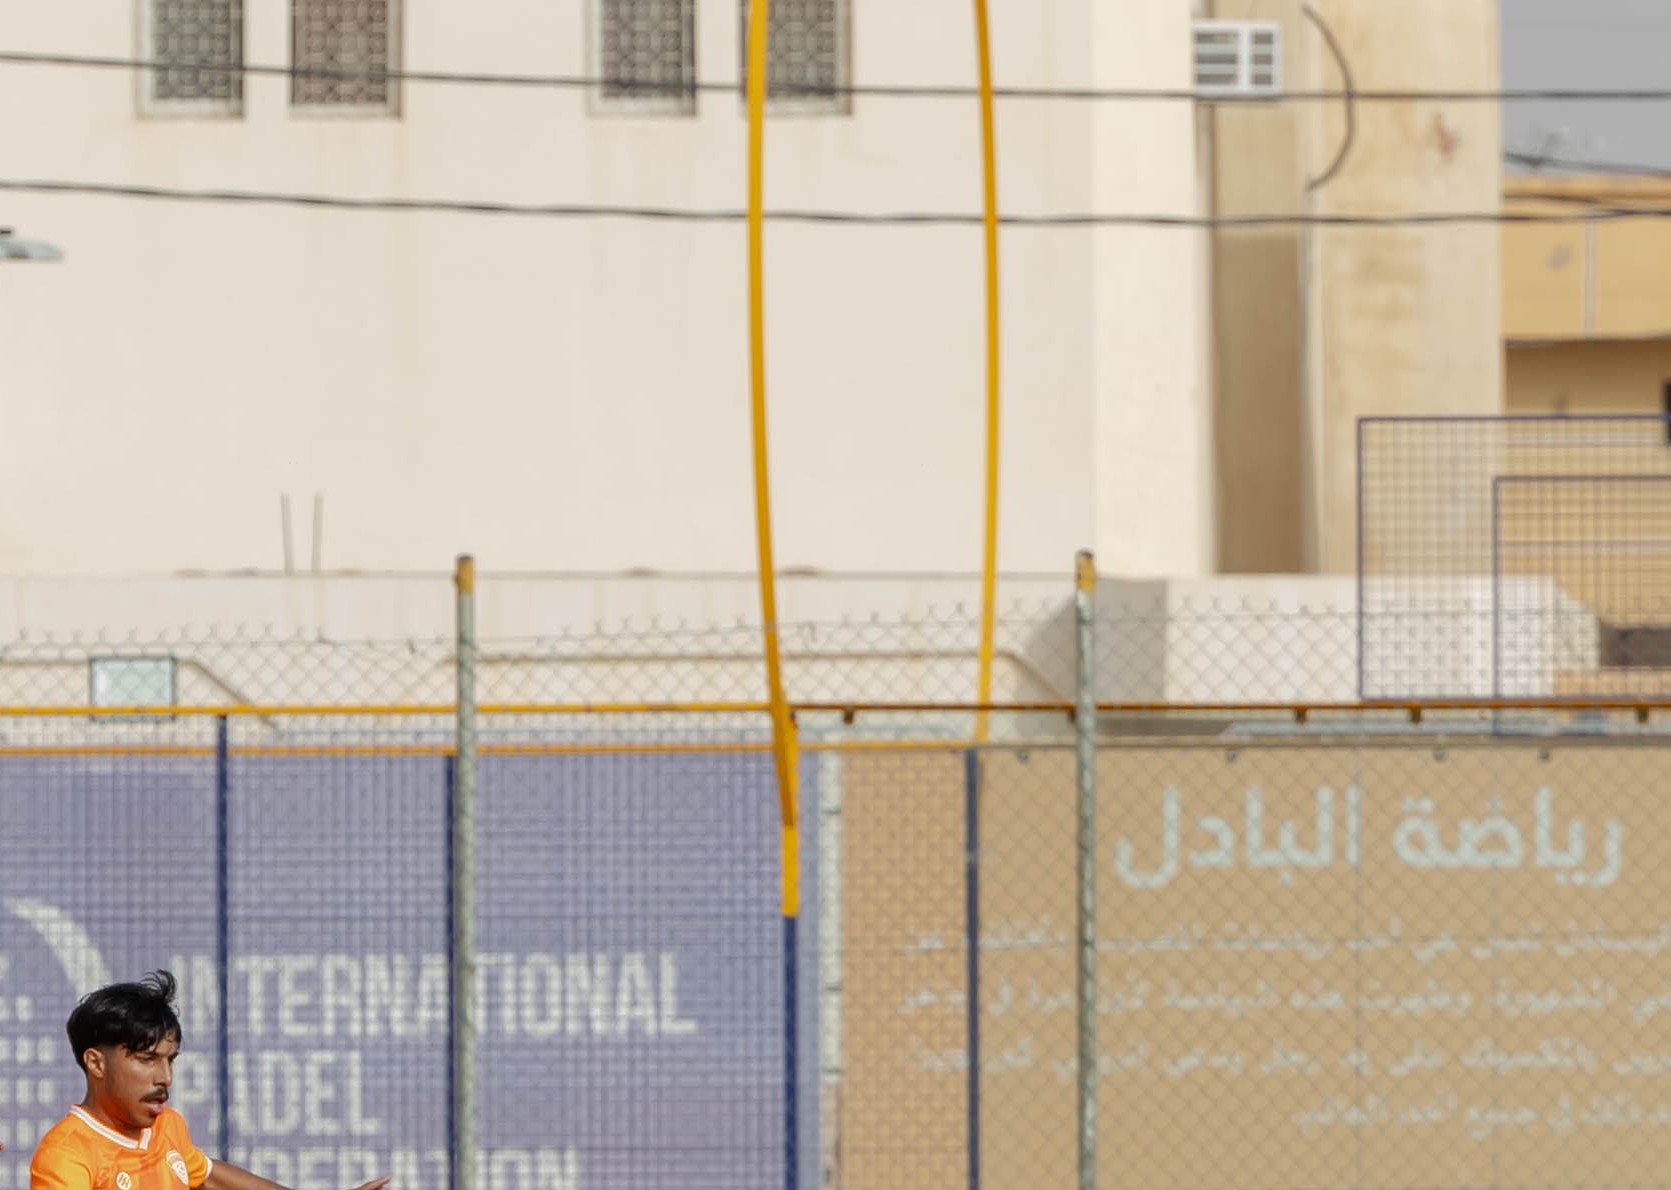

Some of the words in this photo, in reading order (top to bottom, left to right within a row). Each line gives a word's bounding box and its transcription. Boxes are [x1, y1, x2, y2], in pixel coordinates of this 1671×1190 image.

[1113, 785, 1360, 889] البادل
[1393, 785, 1622, 888] رياضة
[171, 953, 698, 1037] INTERNATIONAL
[173, 1049, 382, 1136] PADEL
